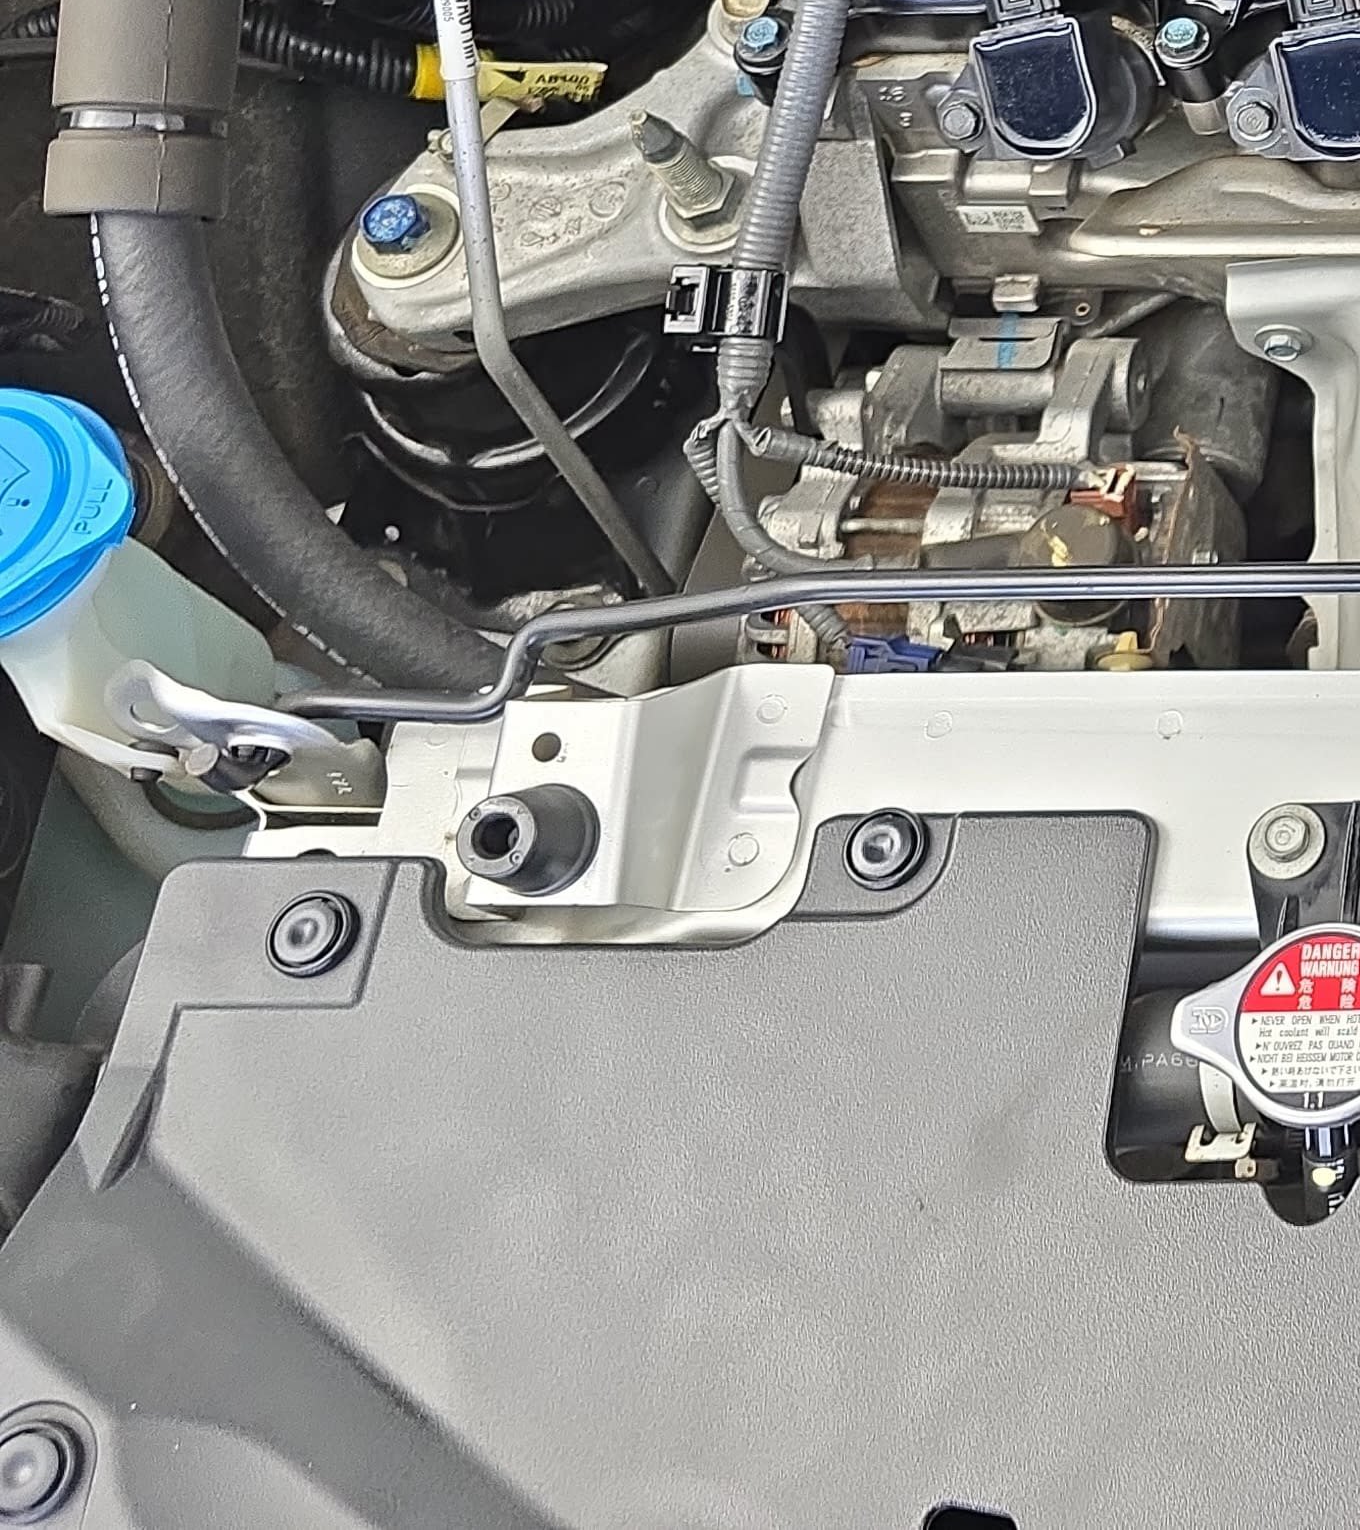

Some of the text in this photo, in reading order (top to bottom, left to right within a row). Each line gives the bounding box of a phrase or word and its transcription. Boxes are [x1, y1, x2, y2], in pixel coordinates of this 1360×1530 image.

[72, 478, 113, 535] PULL
[1300, 960, 1360, 978] WARNUNG
[1261, 1016, 1286, 1025] NEVER
[1291, 1015, 1312, 1025] OPEN
[1319, 1014, 1341, 1024] WHEN
[1259, 1028, 1272, 1037] Hot
[1279, 1027, 1309, 1037] coolant
[1315, 1027, 1329, 1037] will
[1337, 1026, 1358, 1037] scald
[1308, 1040, 1323, 1050] PAS
[1328, 1039, 1355, 1050] QUAND
[1257, 1054, 1279, 1063] NICHT
[1281, 1053, 1293, 1063] BEI
[1296, 1053, 1327, 1063] HEISSEM
[1329, 1052, 1354, 1062] MOTOR
[1303, 1092, 1324, 1109] 1.1
